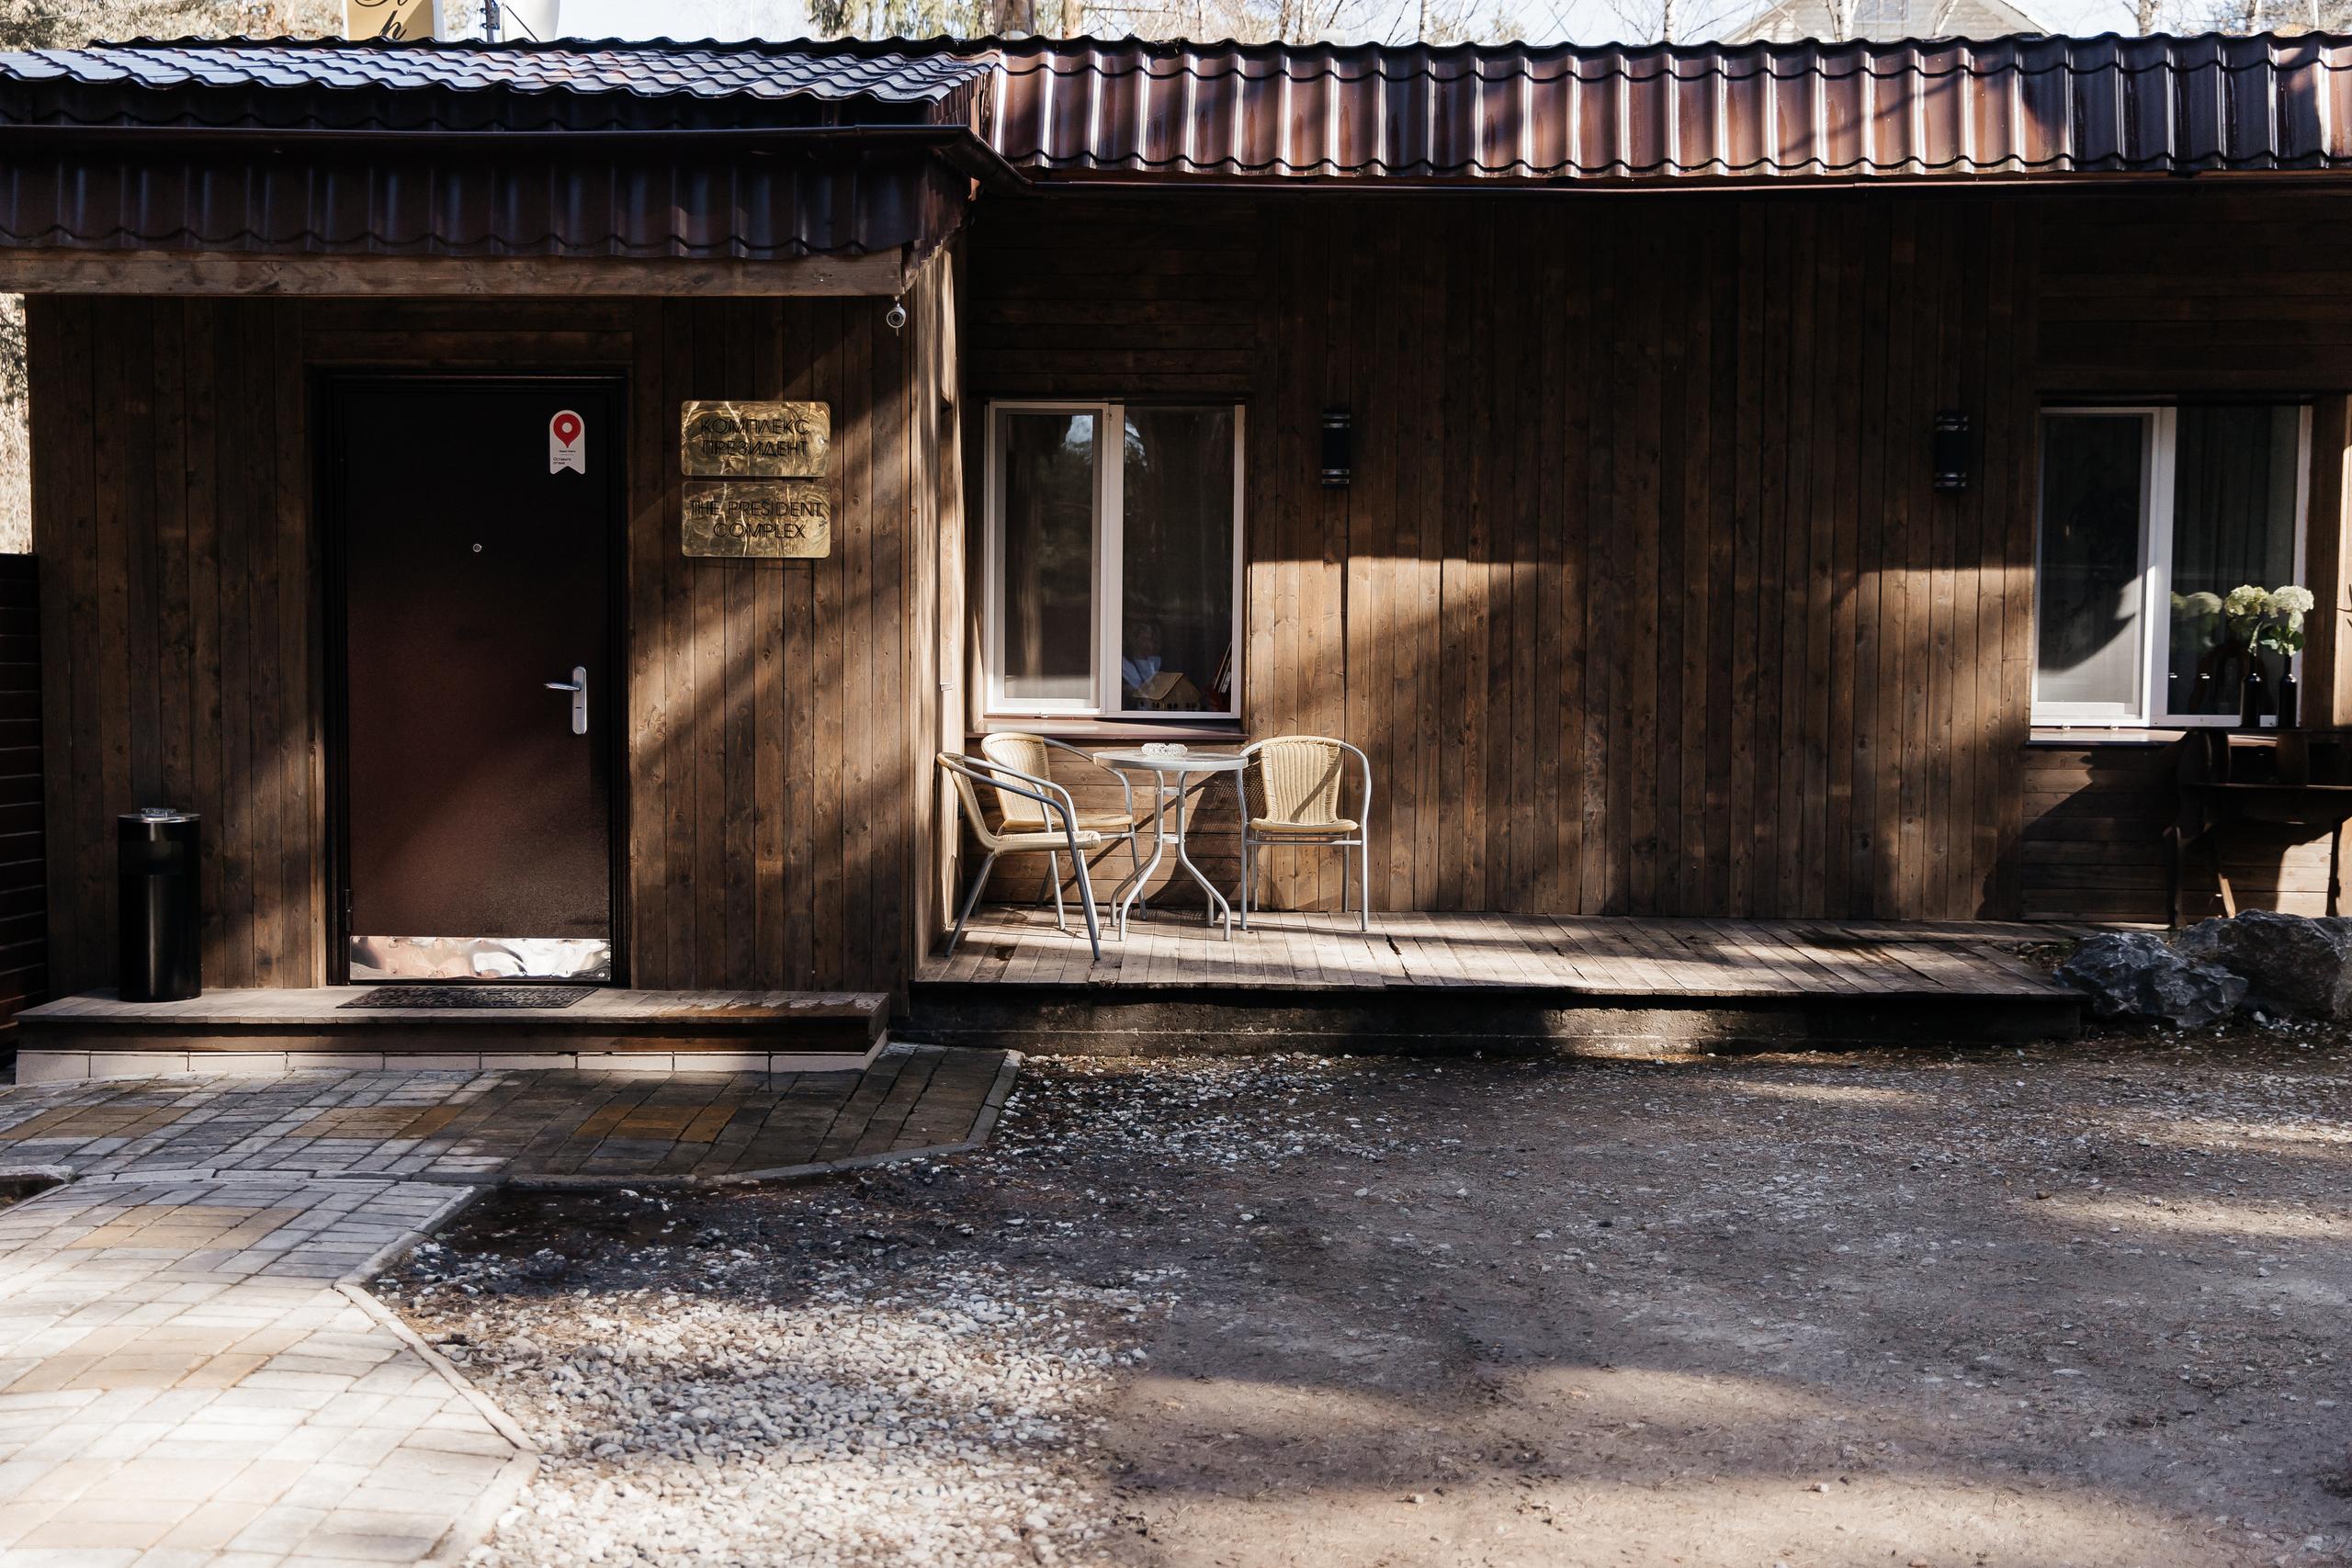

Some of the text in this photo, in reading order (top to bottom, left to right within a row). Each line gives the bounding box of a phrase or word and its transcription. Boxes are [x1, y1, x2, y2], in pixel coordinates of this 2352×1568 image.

[700, 418, 810, 434] КОМПЛЕКС
[702, 440, 808, 457] ПРЕЗИДЕНТ
[690, 500, 824, 516] THE PRESIDENT
[713, 523, 806, 538] COMPLEX
